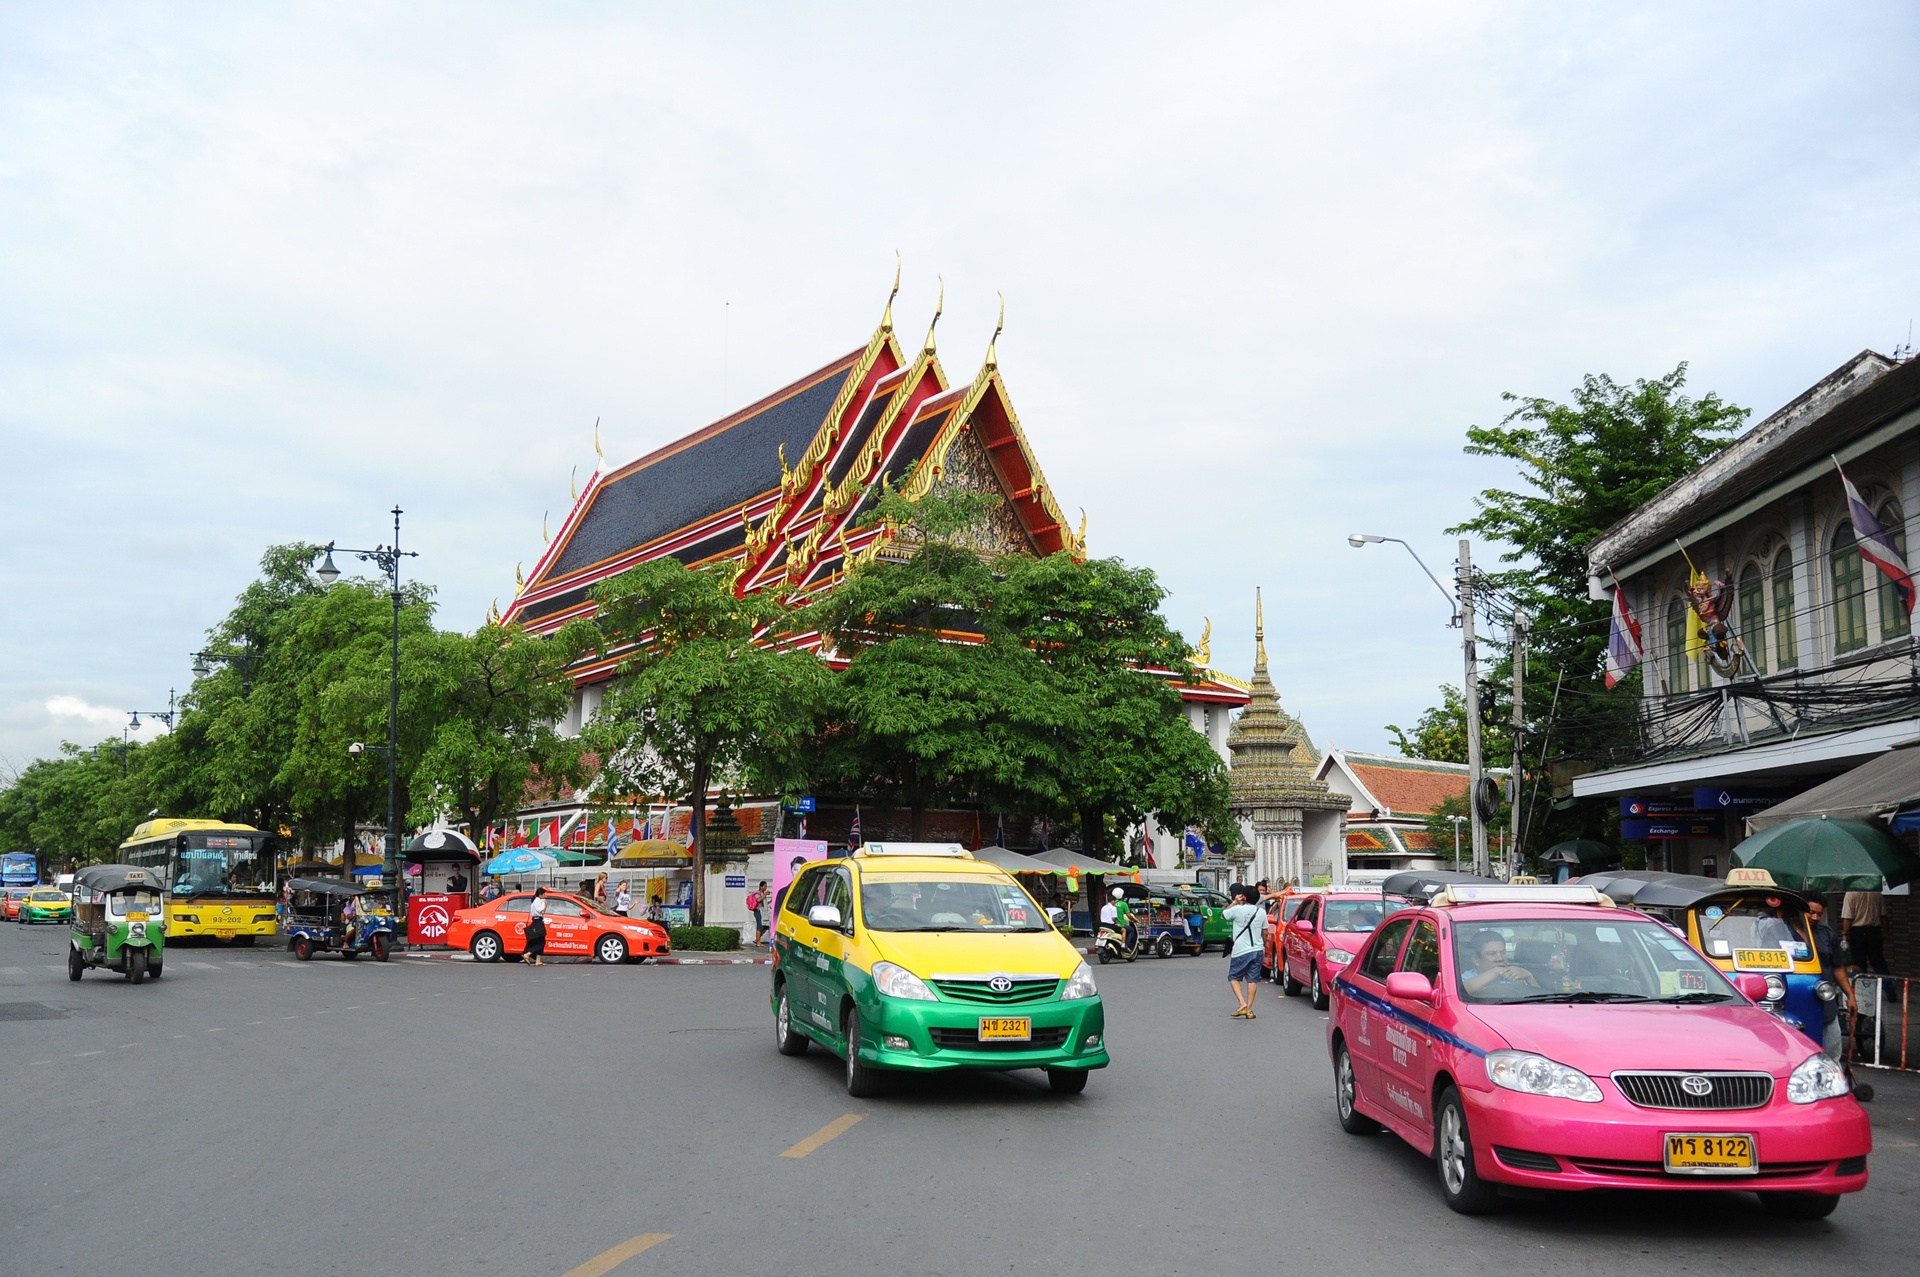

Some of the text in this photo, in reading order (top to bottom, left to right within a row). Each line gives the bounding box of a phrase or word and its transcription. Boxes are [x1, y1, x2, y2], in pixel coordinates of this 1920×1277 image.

[1736, 870, 1767, 881] TAXI
[257, 881, 274, 892] 44
[421, 925, 446, 937] AIA
[1738, 951, 1787, 962] สก 6315
[1003, 1020, 1026, 1031] 2321
[1671, 1138, 1747, 1157] ทร 8122
